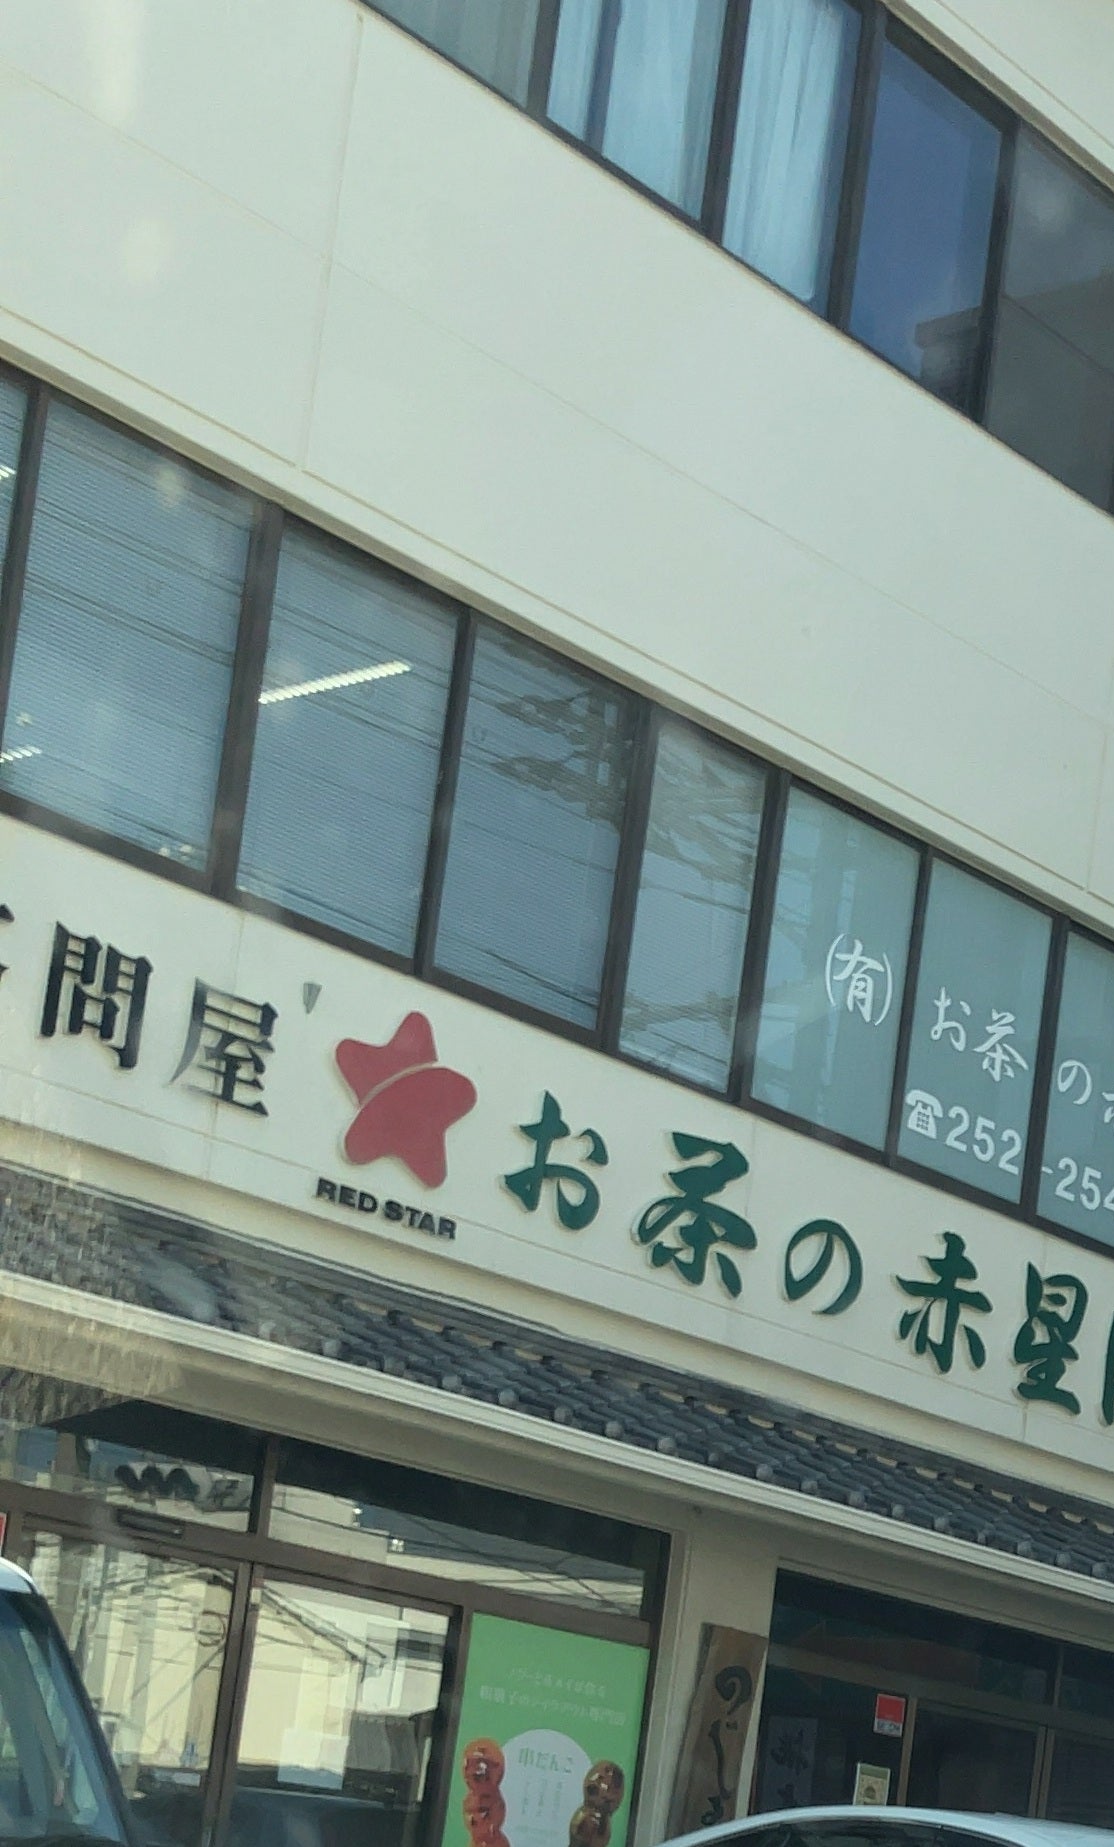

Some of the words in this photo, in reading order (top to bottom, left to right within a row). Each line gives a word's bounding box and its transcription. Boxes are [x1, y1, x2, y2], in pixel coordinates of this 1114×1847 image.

[0, 903, 278, 1117] 問屋
[315, 1176, 378, 1213] RED
[383, 1199, 457, 1240] STAR
